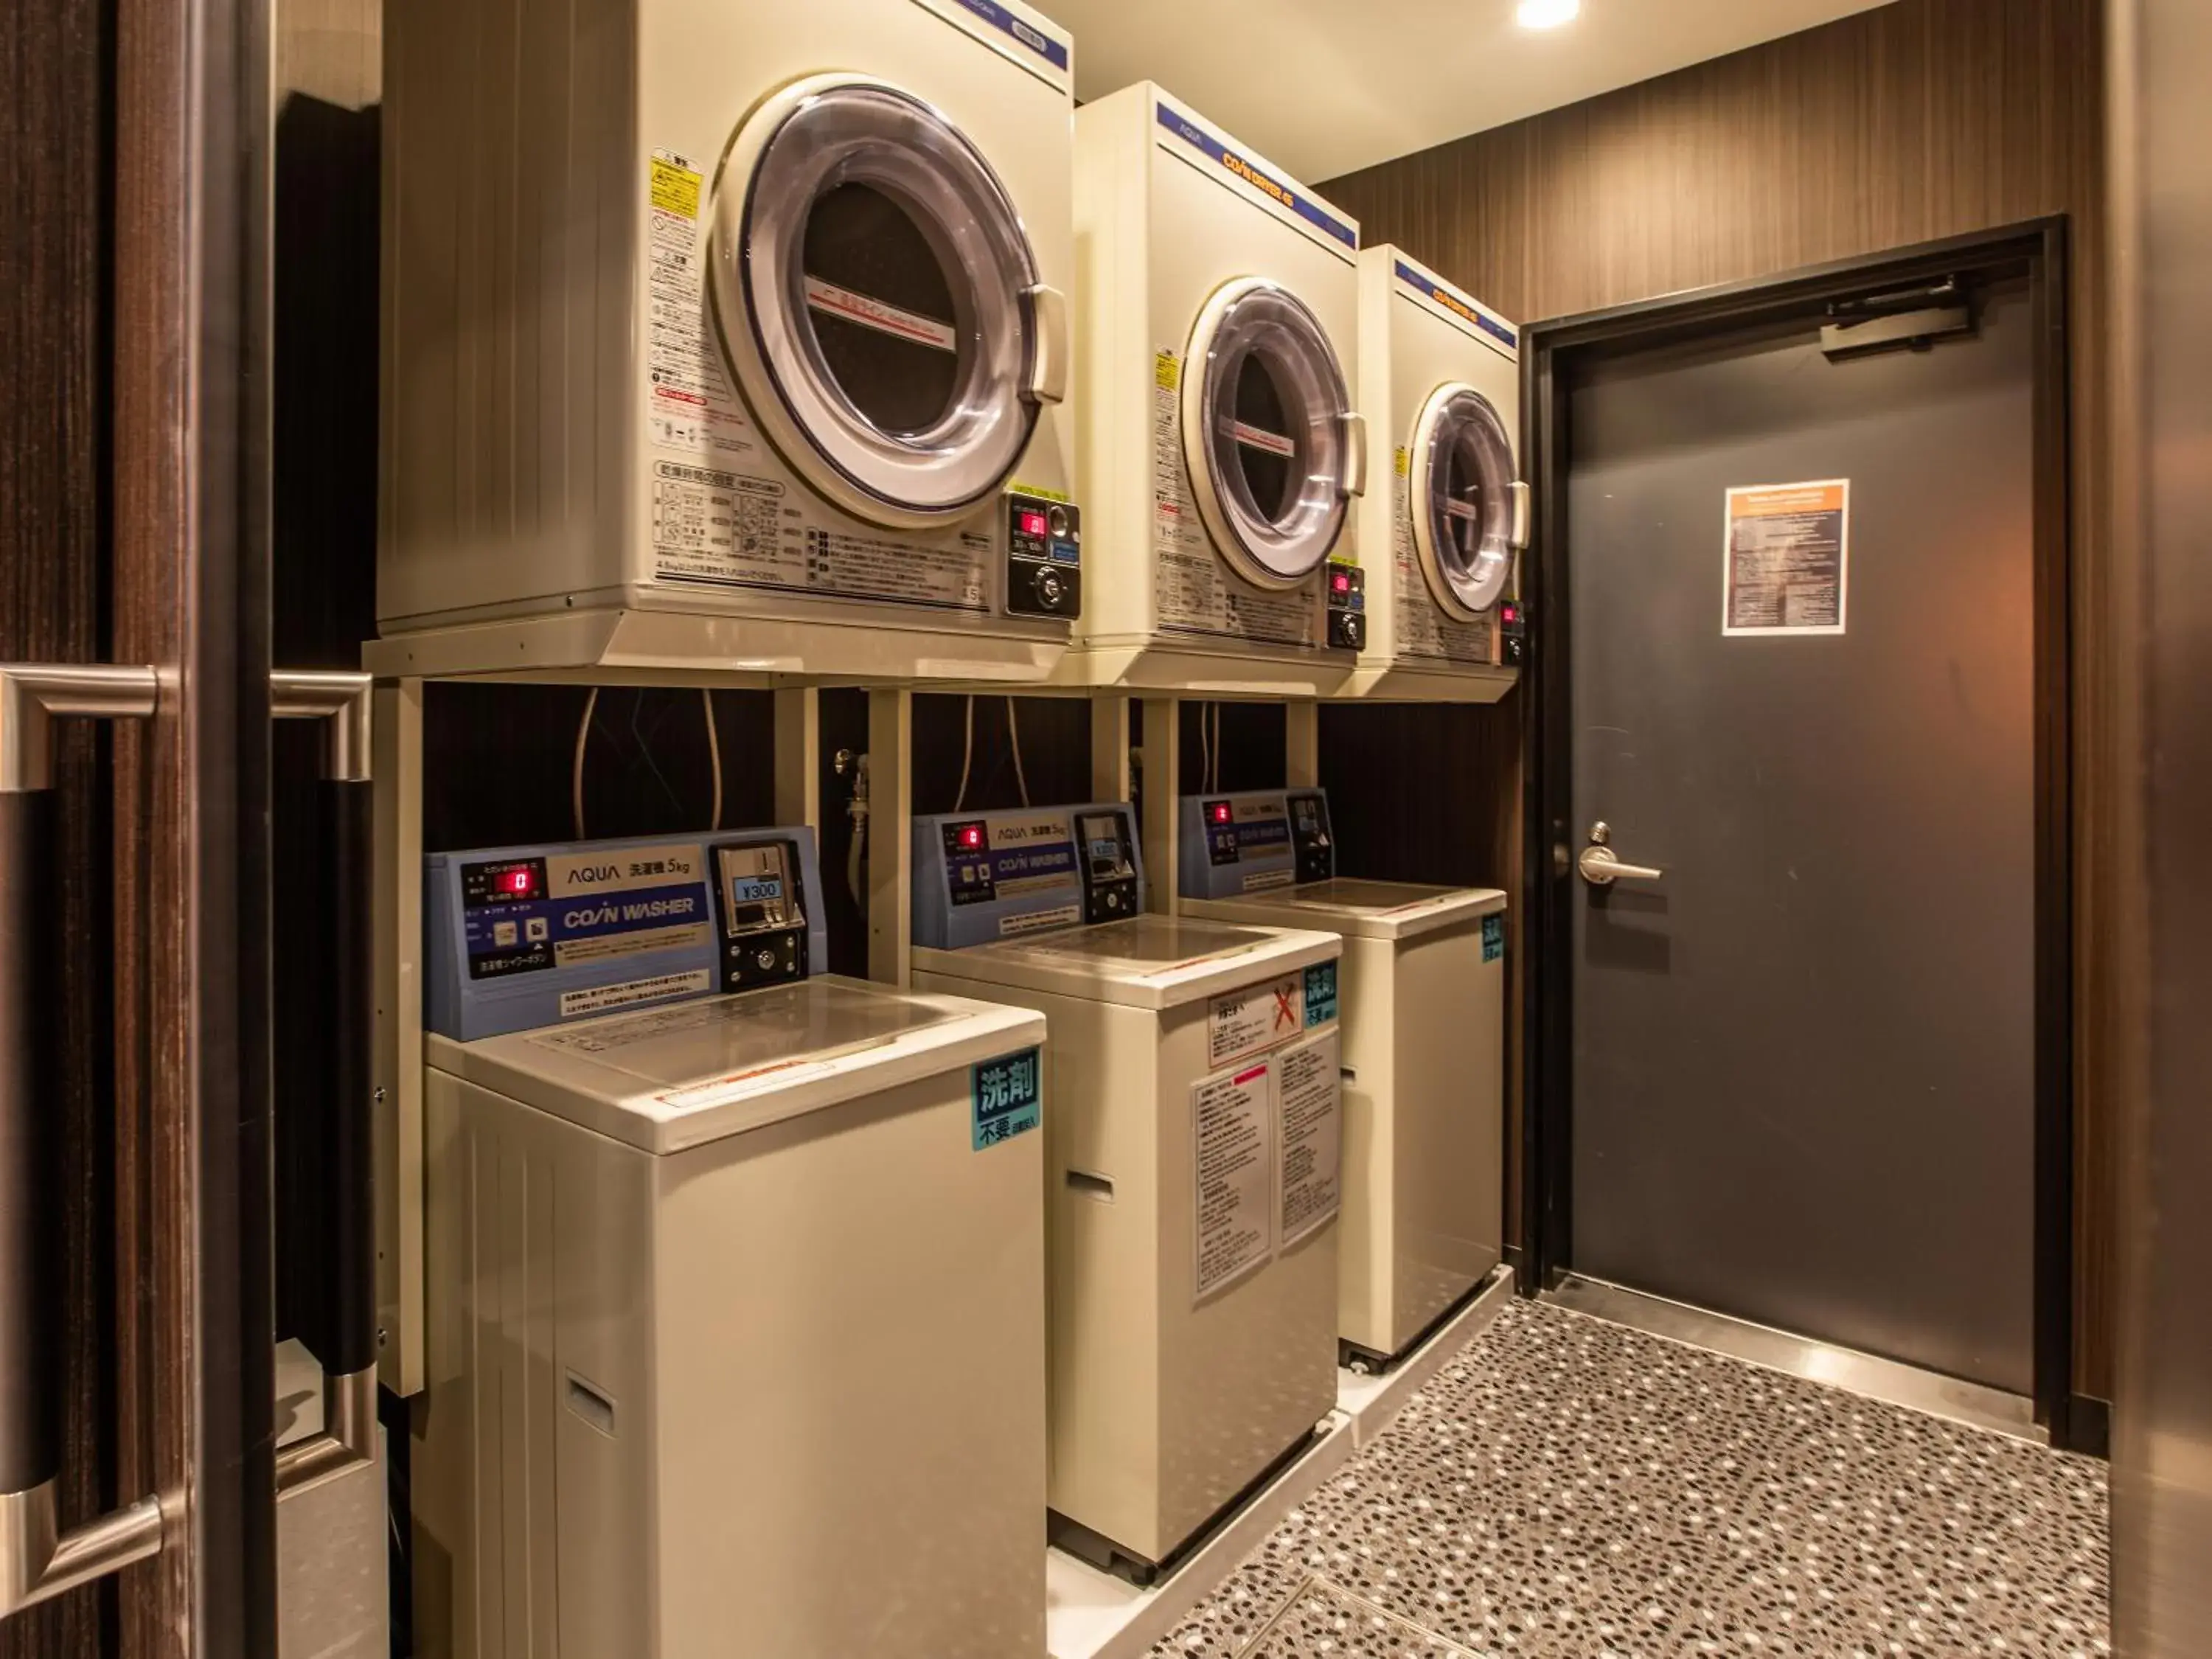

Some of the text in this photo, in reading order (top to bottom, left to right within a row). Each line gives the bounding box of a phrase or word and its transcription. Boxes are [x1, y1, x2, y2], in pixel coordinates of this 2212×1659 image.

[515, 873, 526, 889] 0
[568, 865, 621, 884] AQUA
[668, 858, 690, 874] 5kg
[564, 897, 695, 929] COIN WASHER
[981, 1056, 1034, 1113] 洗剤
[979, 1116, 1011, 1145] 不要
